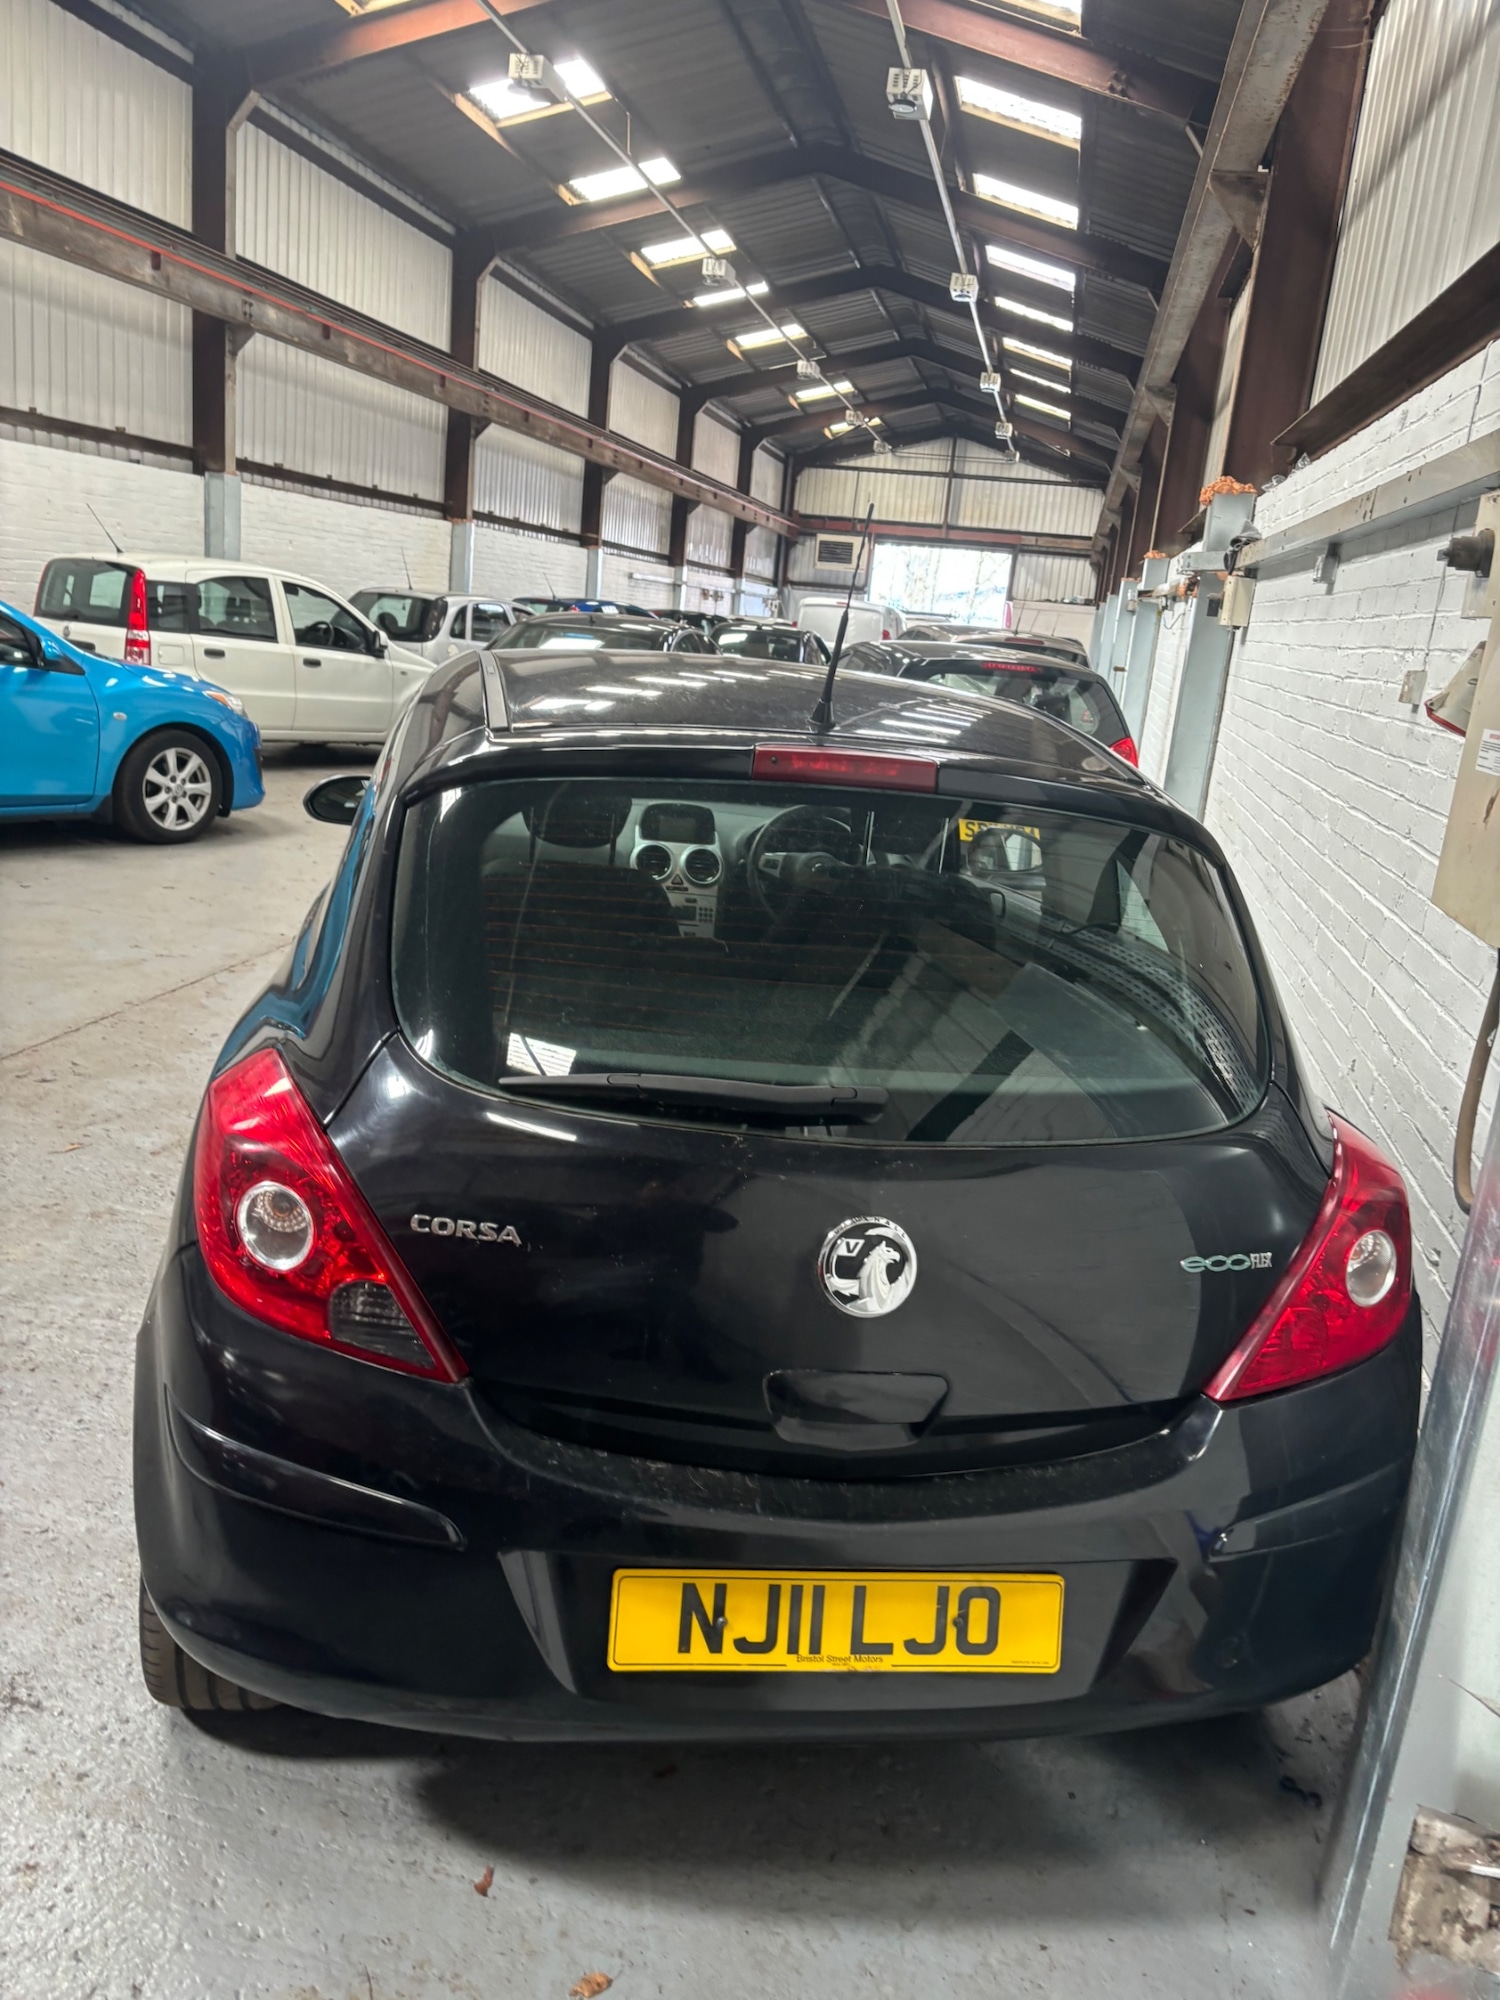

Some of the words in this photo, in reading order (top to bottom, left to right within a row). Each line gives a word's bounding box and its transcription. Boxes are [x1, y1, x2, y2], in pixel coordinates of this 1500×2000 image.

[410, 1213, 522, 1247] CORSA
[845, 1240, 861, 1255] V
[677, 1582, 826, 1654] NJ11
[849, 1584, 1002, 1656] LJO
[797, 1654, 824, 1663] Bristol
[827, 1654, 851, 1663] Street
[853, 1654, 884, 1663] Motors
